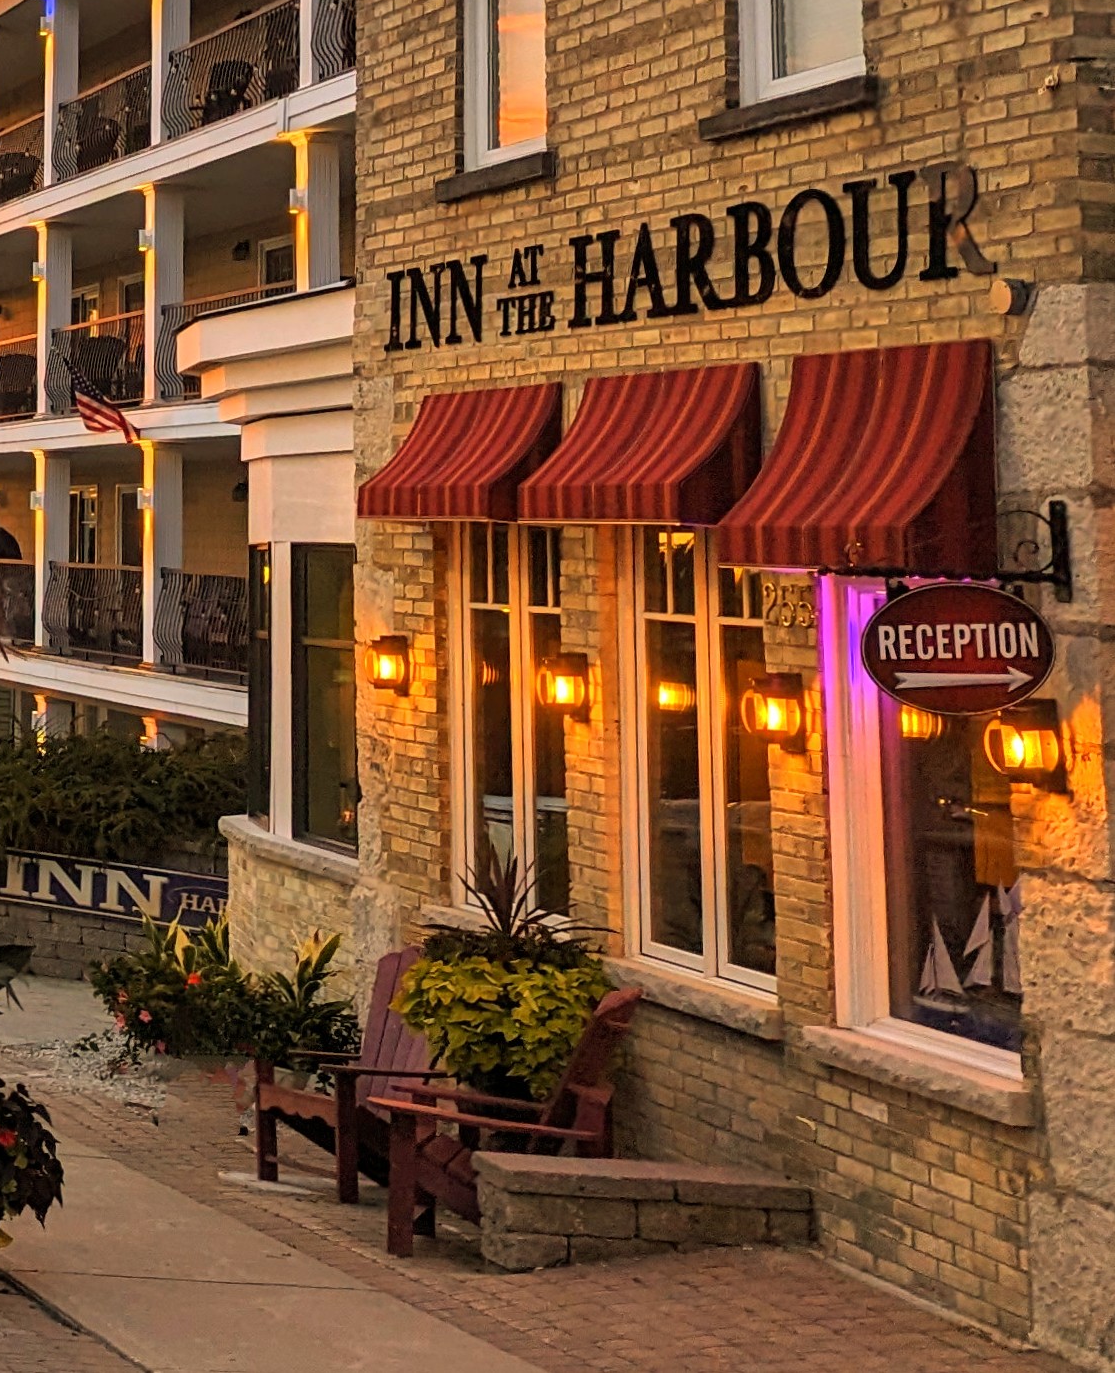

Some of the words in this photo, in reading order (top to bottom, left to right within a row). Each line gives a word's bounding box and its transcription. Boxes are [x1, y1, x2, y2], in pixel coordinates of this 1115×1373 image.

[507, 244, 545, 289] AT
[568, 161, 998, 329] HARBOUR
[384, 253, 489, 353] INN
[497, 290, 556, 337] THE
[878, 622, 1040, 661] RECEPTION
[0, 855, 170, 918] INN
